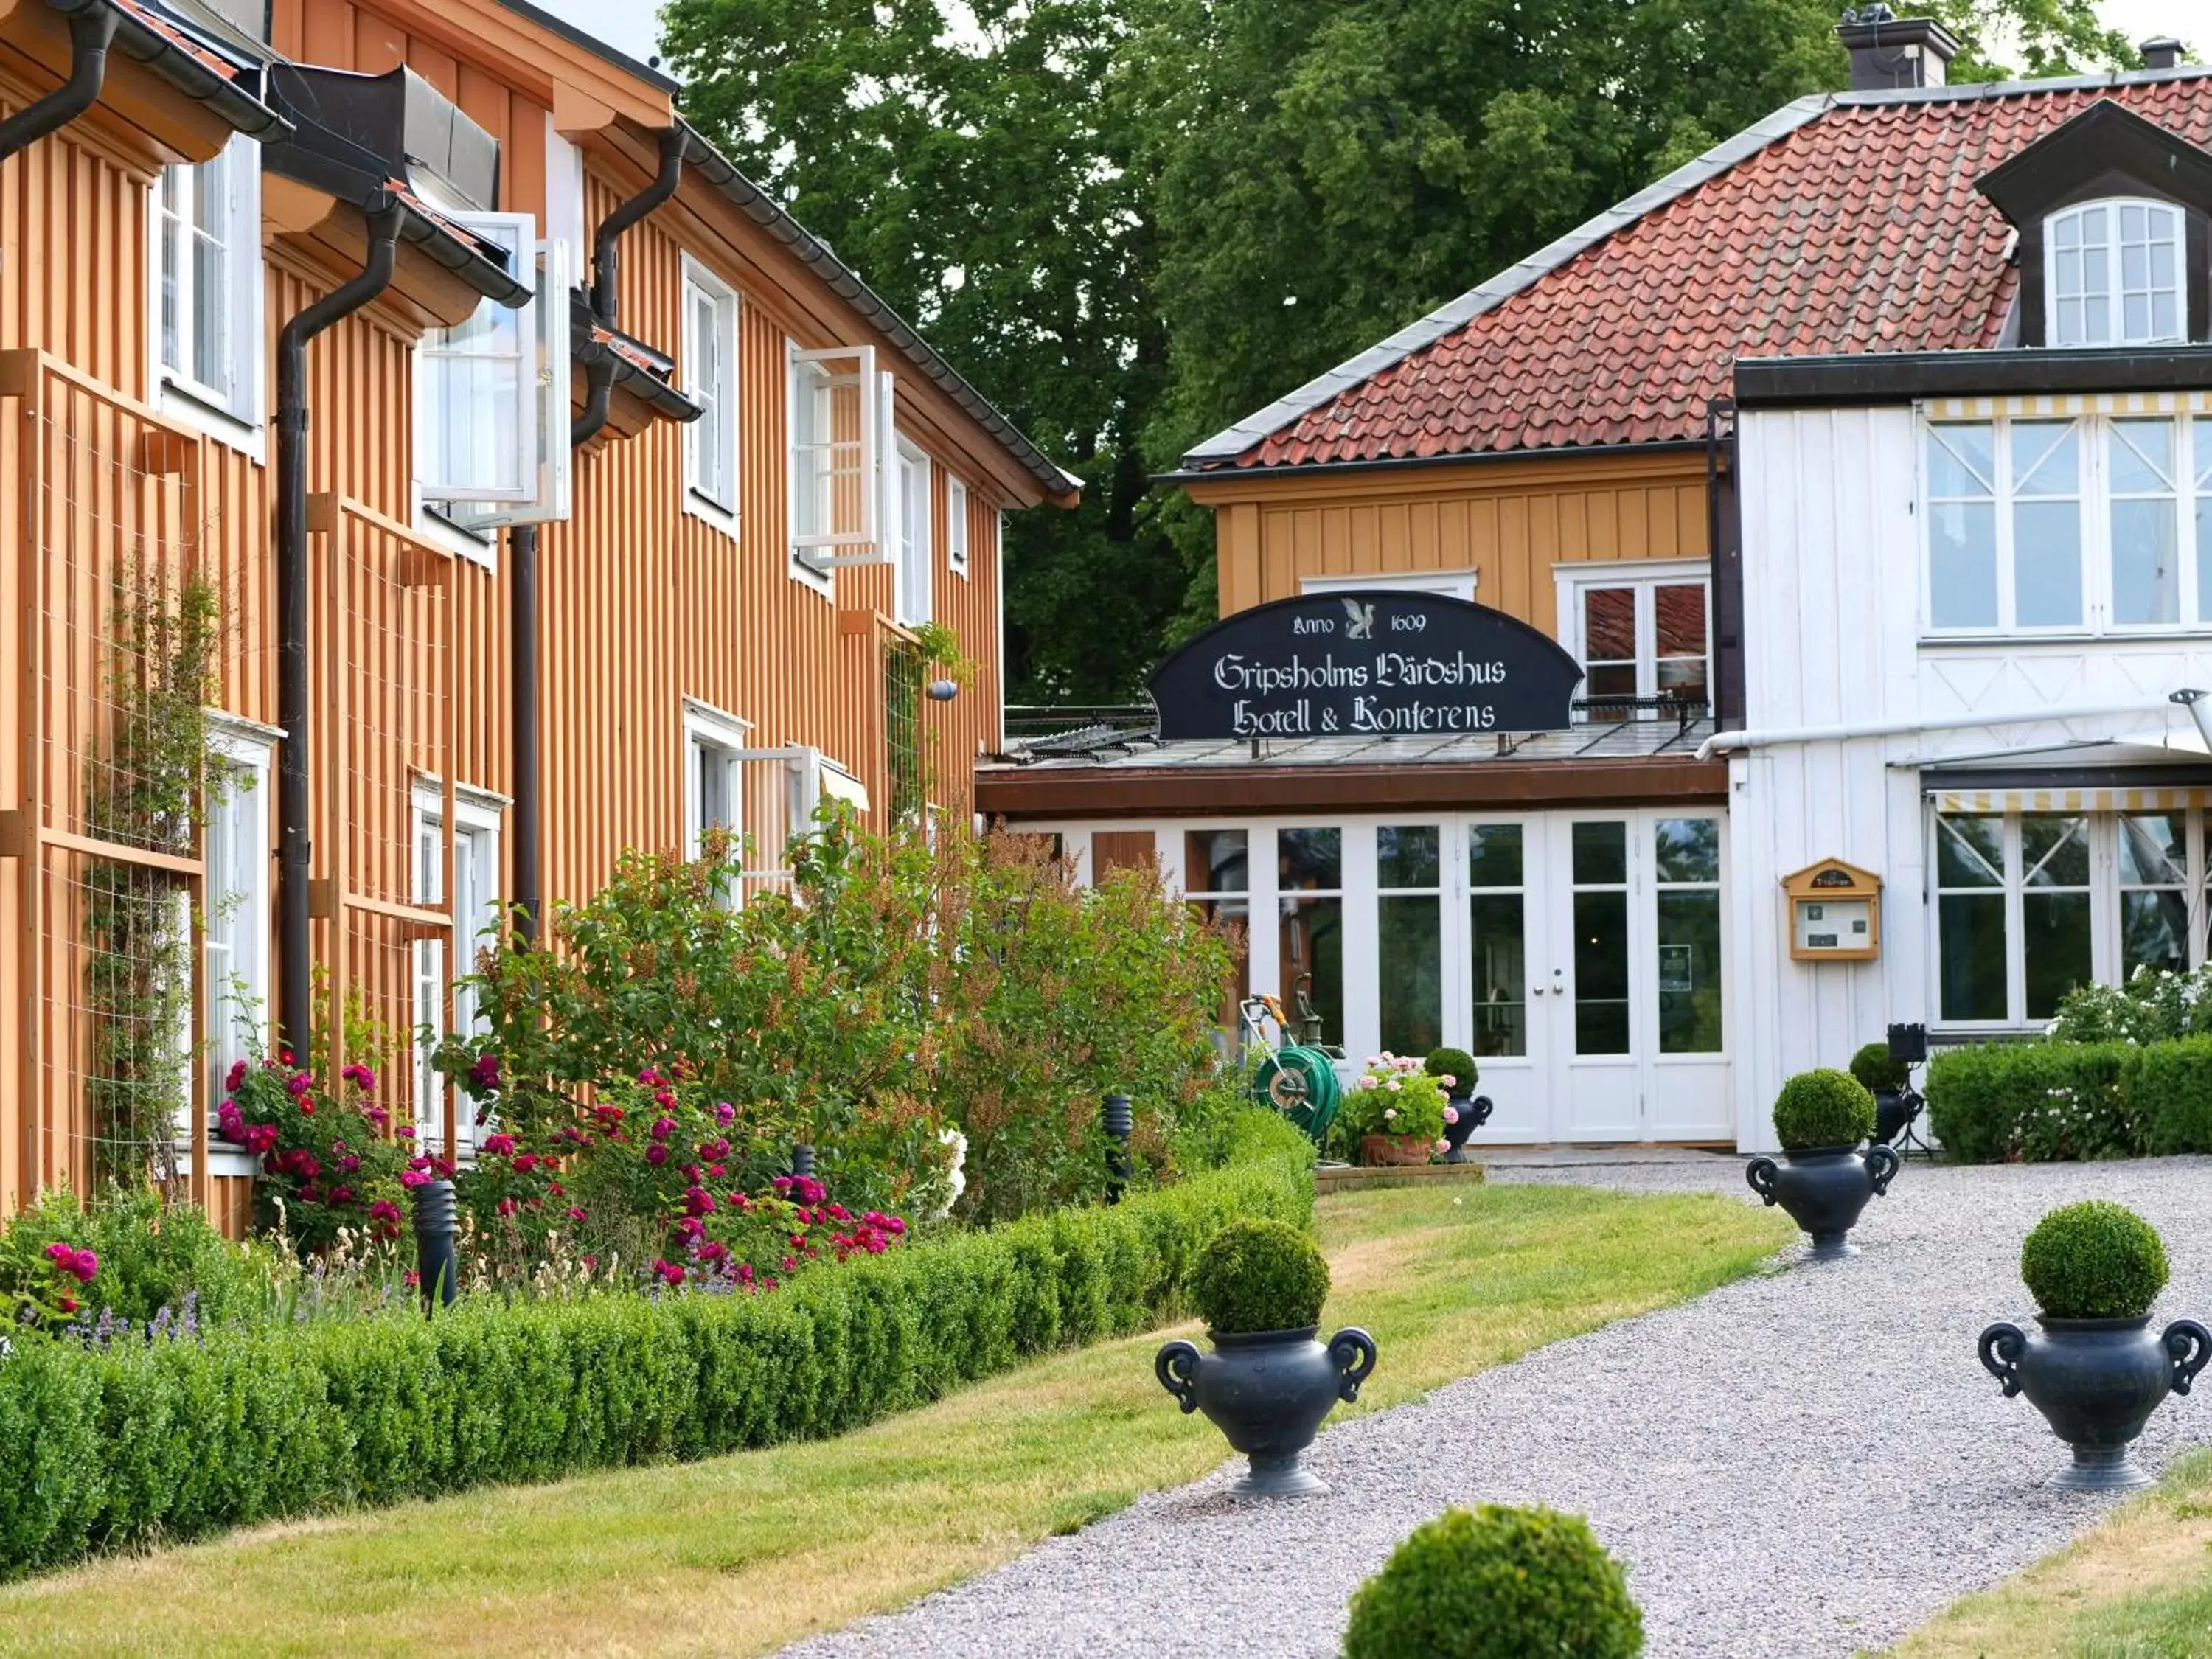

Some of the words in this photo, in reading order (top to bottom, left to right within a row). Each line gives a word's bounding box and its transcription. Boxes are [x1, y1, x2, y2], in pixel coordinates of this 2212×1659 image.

[1293, 616, 1335, 635] Anno
[1391, 614, 1427, 633] 1609
[1214, 653, 1368, 696] Gripsholms
[1376, 650, 1506, 687] Värdshus
[1231, 699, 1311, 737] Hotell
[1321, 706, 1340, 731] &
[1349, 695, 1496, 732] Konferens
